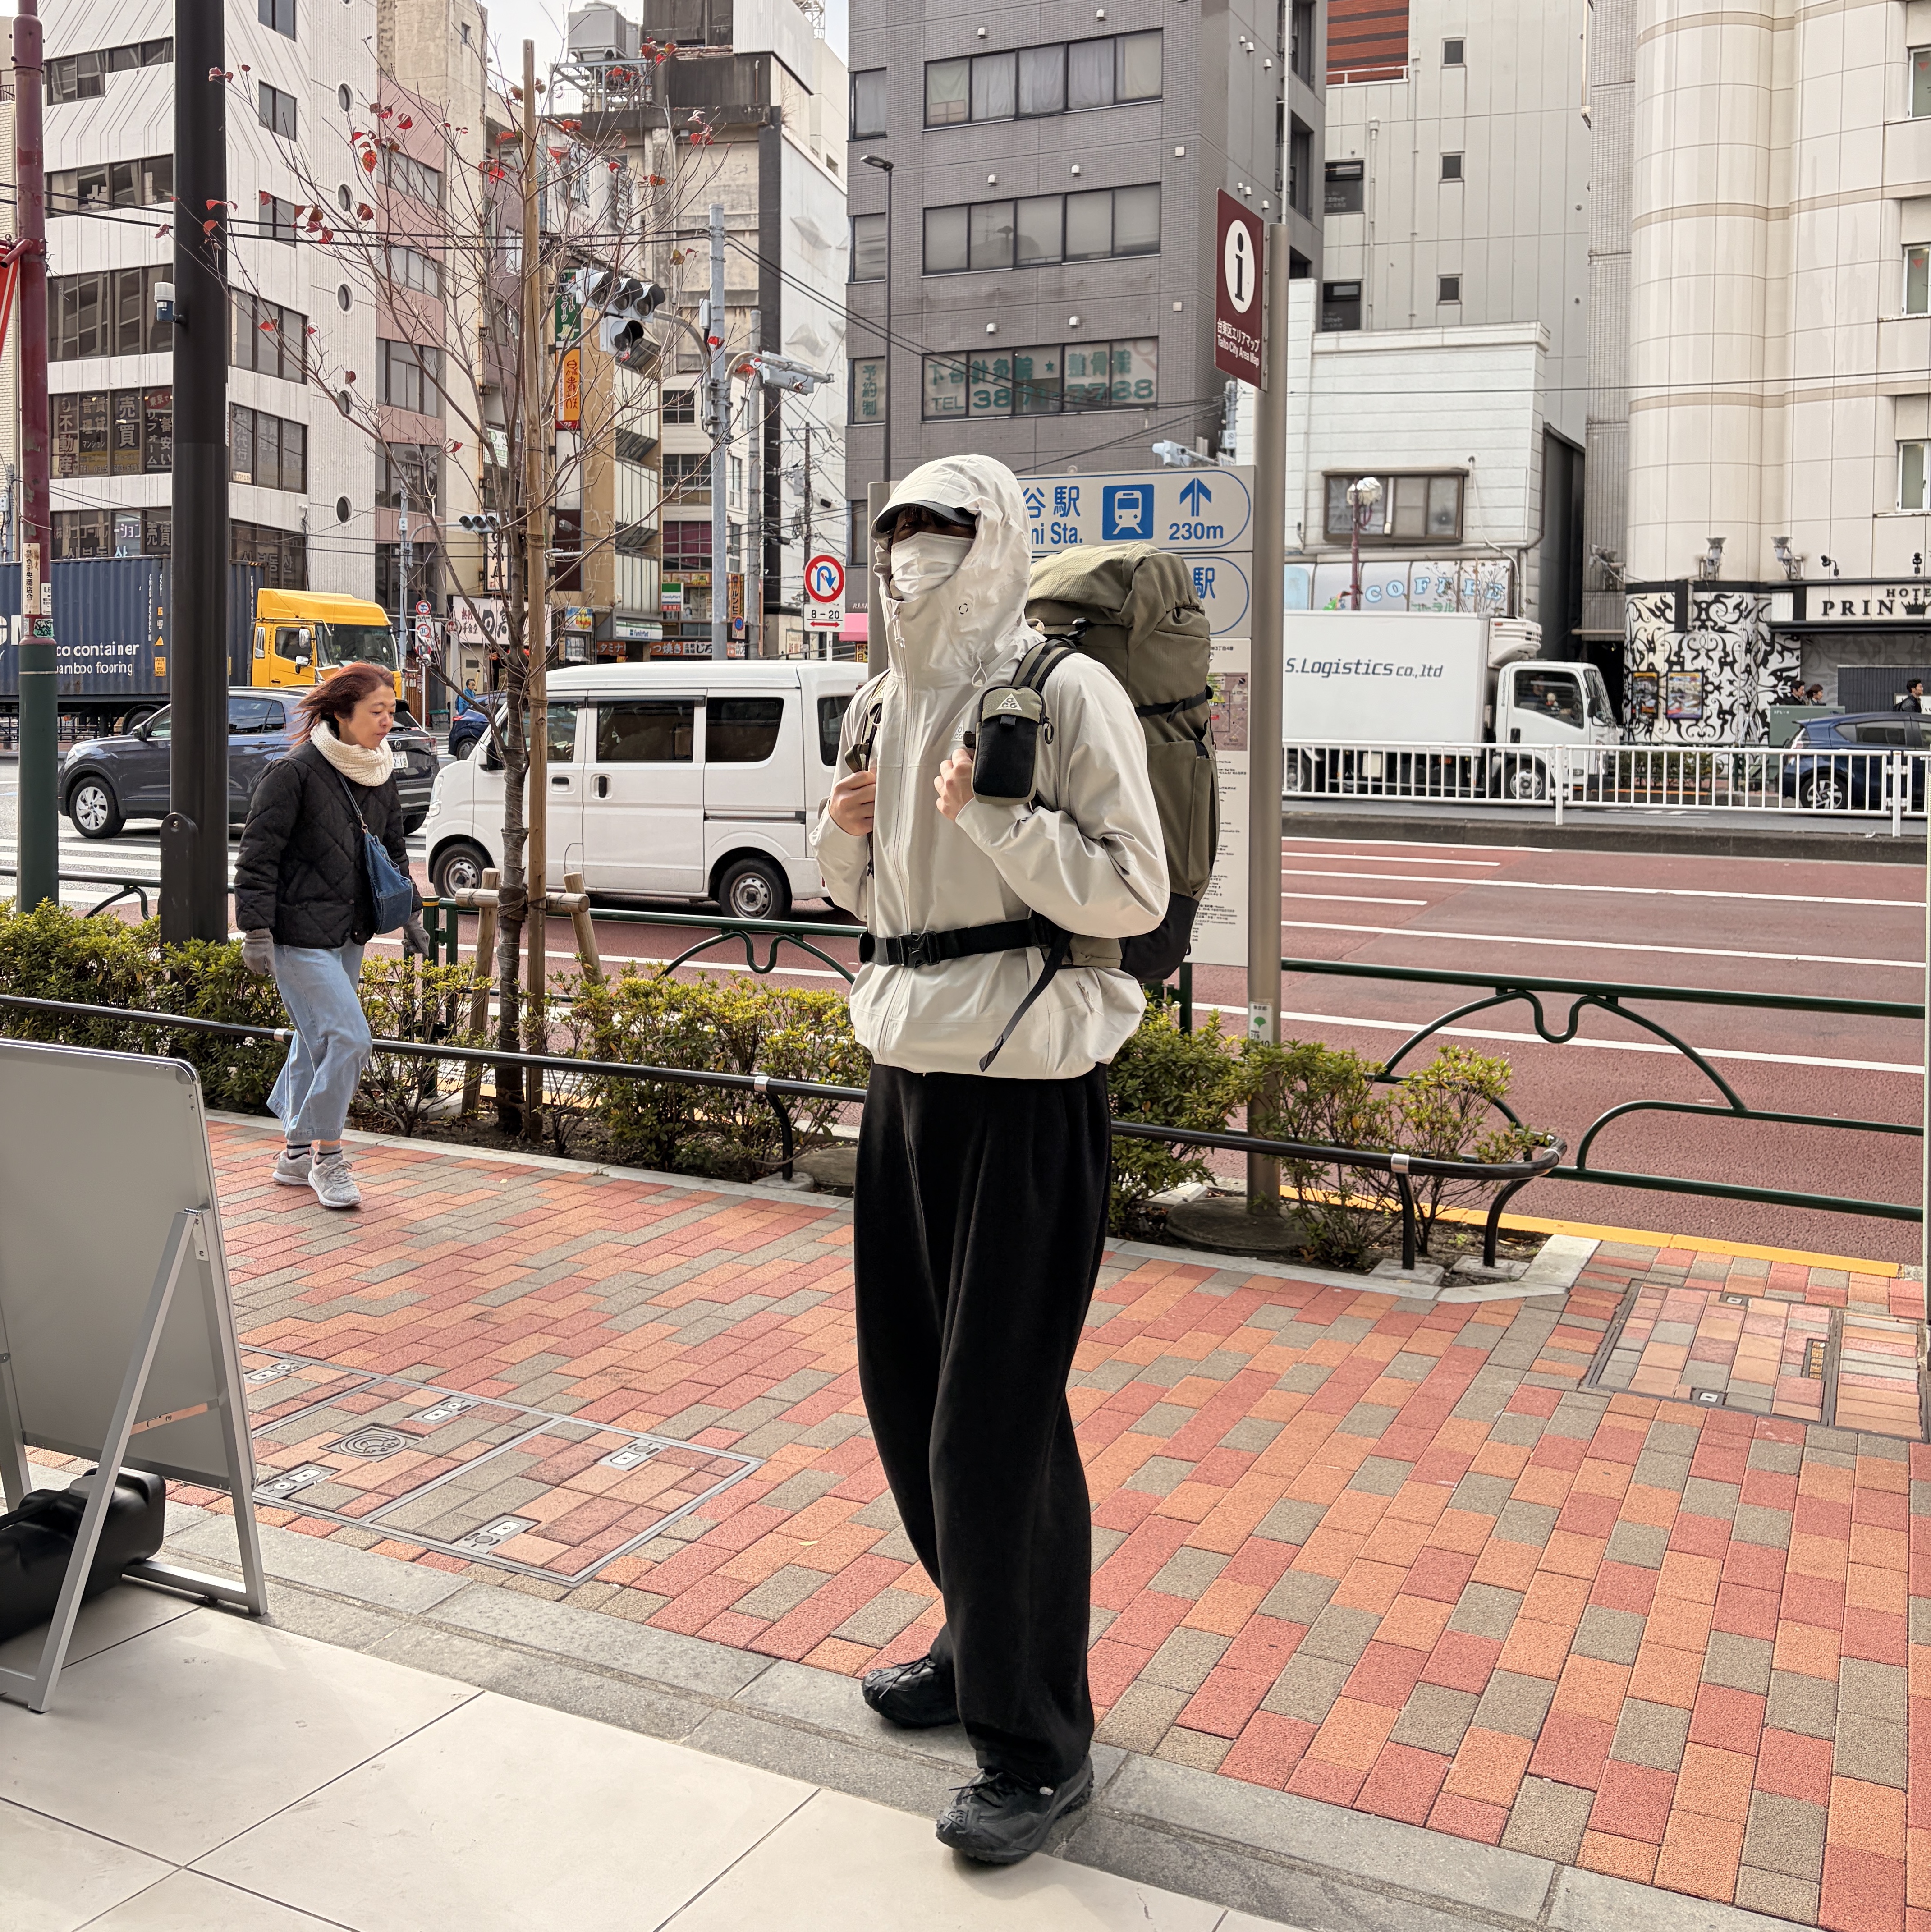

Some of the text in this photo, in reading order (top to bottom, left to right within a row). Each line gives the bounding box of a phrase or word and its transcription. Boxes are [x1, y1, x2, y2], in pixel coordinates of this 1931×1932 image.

[1217, 318, 1260, 352] 台東区エリアマップ
[1217, 335, 1259, 368] Taito City Area Map
[862, 364, 878, 416] 予約制
[931, 397, 964, 411] TEL
[119, 396, 135, 447] 売買
[59, 414, 74, 474] 不動産
[147, 410, 157, 465] リフォーム
[1023, 486, 1080, 518] 谷駅
[1051, 522, 1082, 545] Sta.
[1169, 523, 1224, 541] 230m
[1193, 567, 1216, 600] 駅
[1365, 577, 1504, 603] COFFEE
[1821, 600, 1895, 616] PRIN
[73, 641, 139, 656] container
[96, 661, 133, 676] flooring
[1284, 658, 1443, 678] S.Logistics co.,ltd
